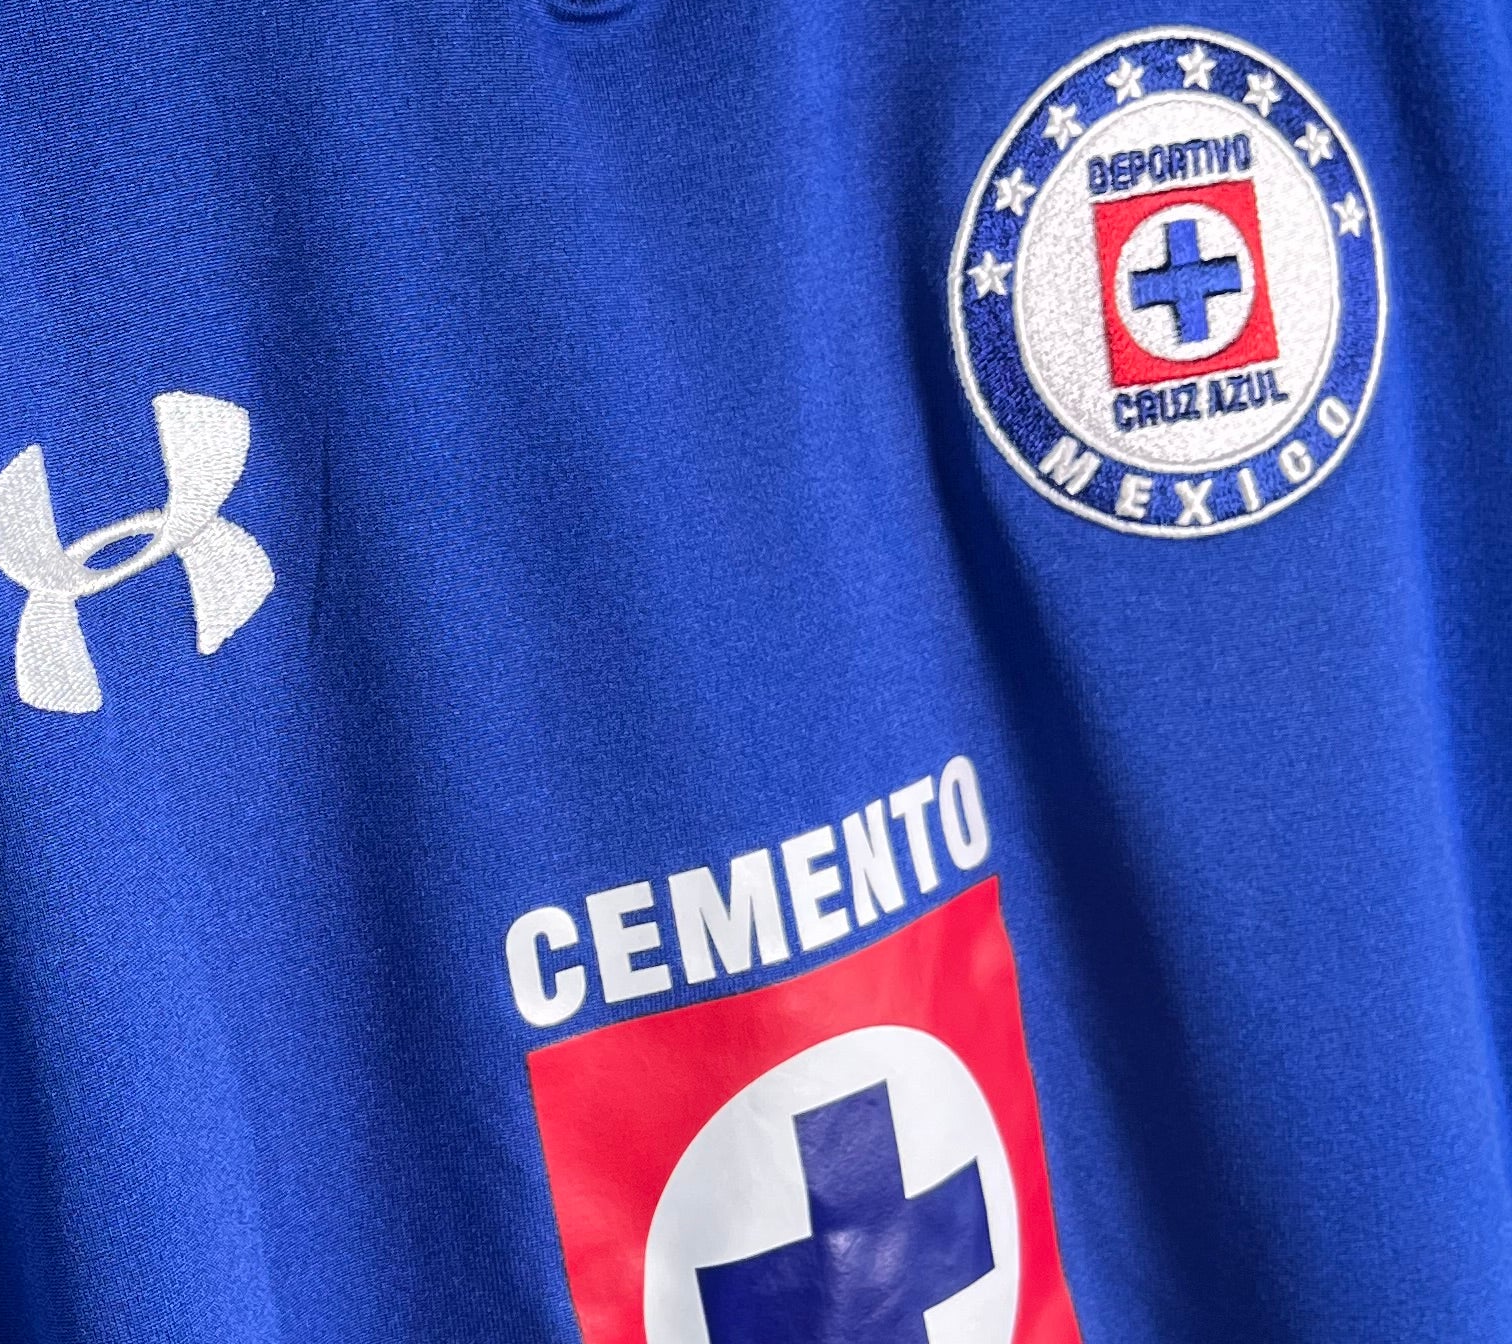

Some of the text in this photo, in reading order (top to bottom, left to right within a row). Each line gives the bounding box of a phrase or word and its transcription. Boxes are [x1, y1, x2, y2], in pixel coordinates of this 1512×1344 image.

[1088, 134, 1252, 194] DEPORTIVO
[1113, 369, 1288, 431] CRUZ AZUL
[1039, 395, 1351, 526] MEXICO
[504, 754, 990, 1028] CEMENTO
